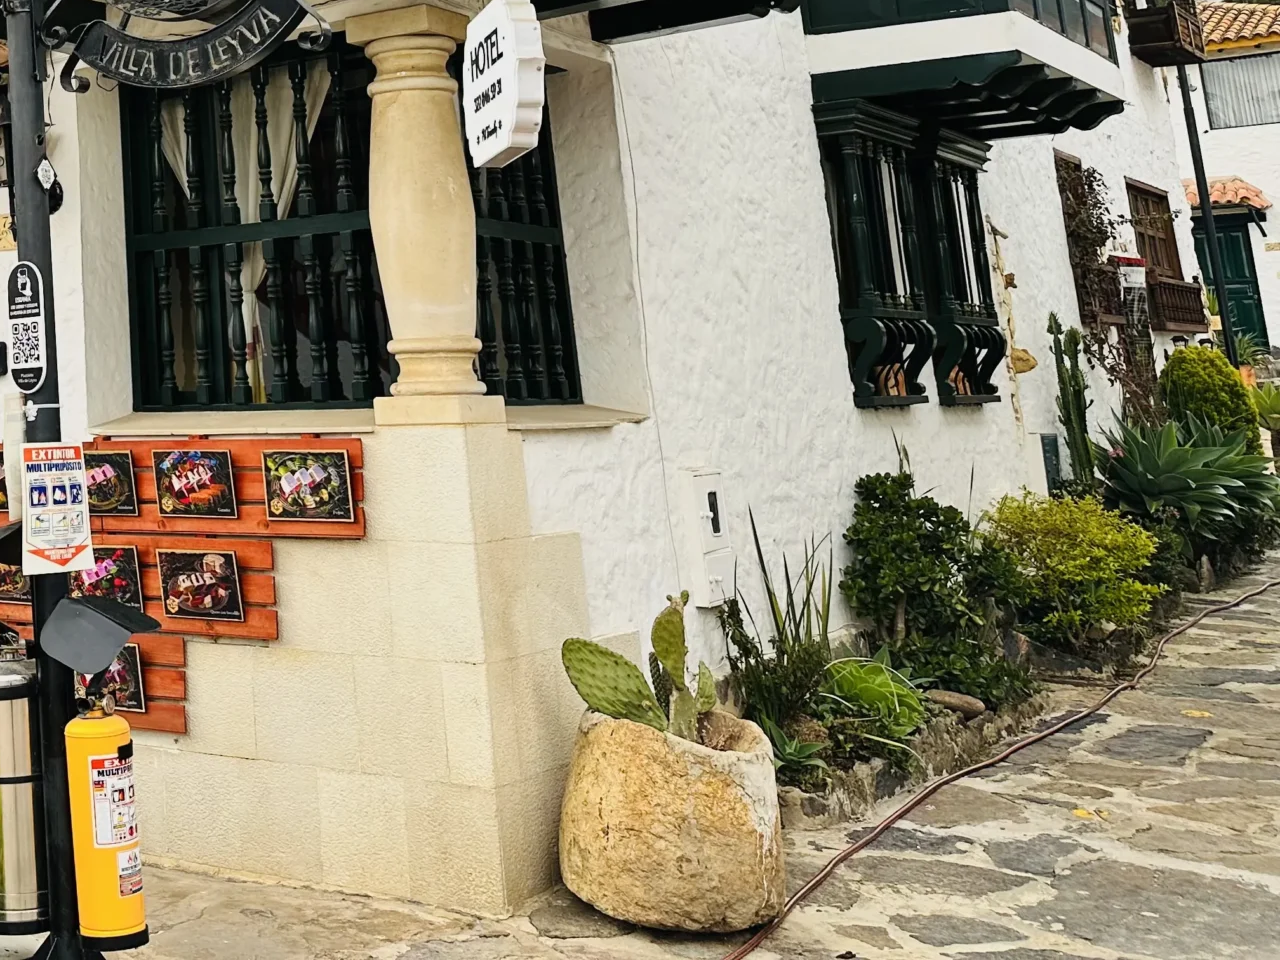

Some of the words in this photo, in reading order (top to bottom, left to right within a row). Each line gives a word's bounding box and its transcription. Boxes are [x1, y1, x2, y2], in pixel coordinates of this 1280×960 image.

[170, 47, 202, 80] DE
[207, 5, 281, 70] LEYVA
[470, 27, 504, 83] HOTEL
[31, 448, 76, 461] EXTINTOR
